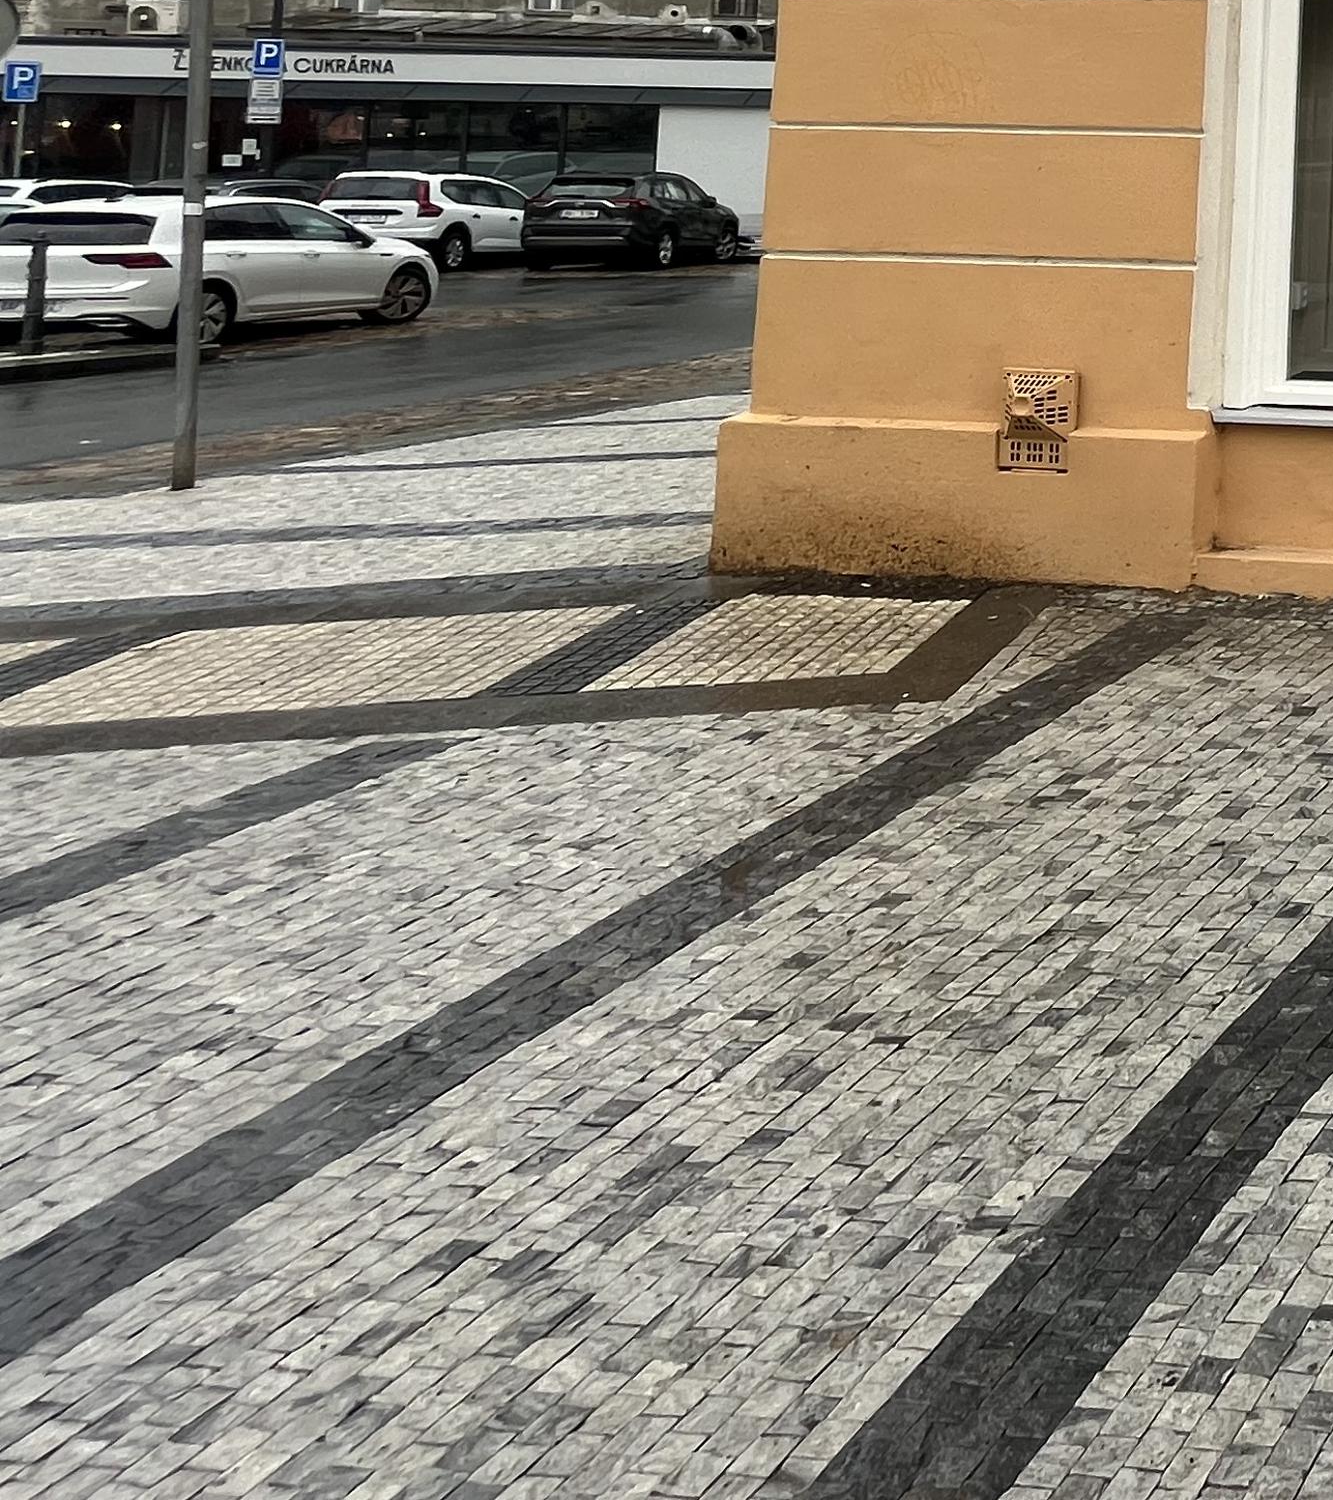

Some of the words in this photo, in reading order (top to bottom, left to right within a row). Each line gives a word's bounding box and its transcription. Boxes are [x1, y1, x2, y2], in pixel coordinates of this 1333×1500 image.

[260, 44, 278, 66] P
[294, 54, 394, 74] CUKRÁRNA
[12, 66, 34, 90] P
